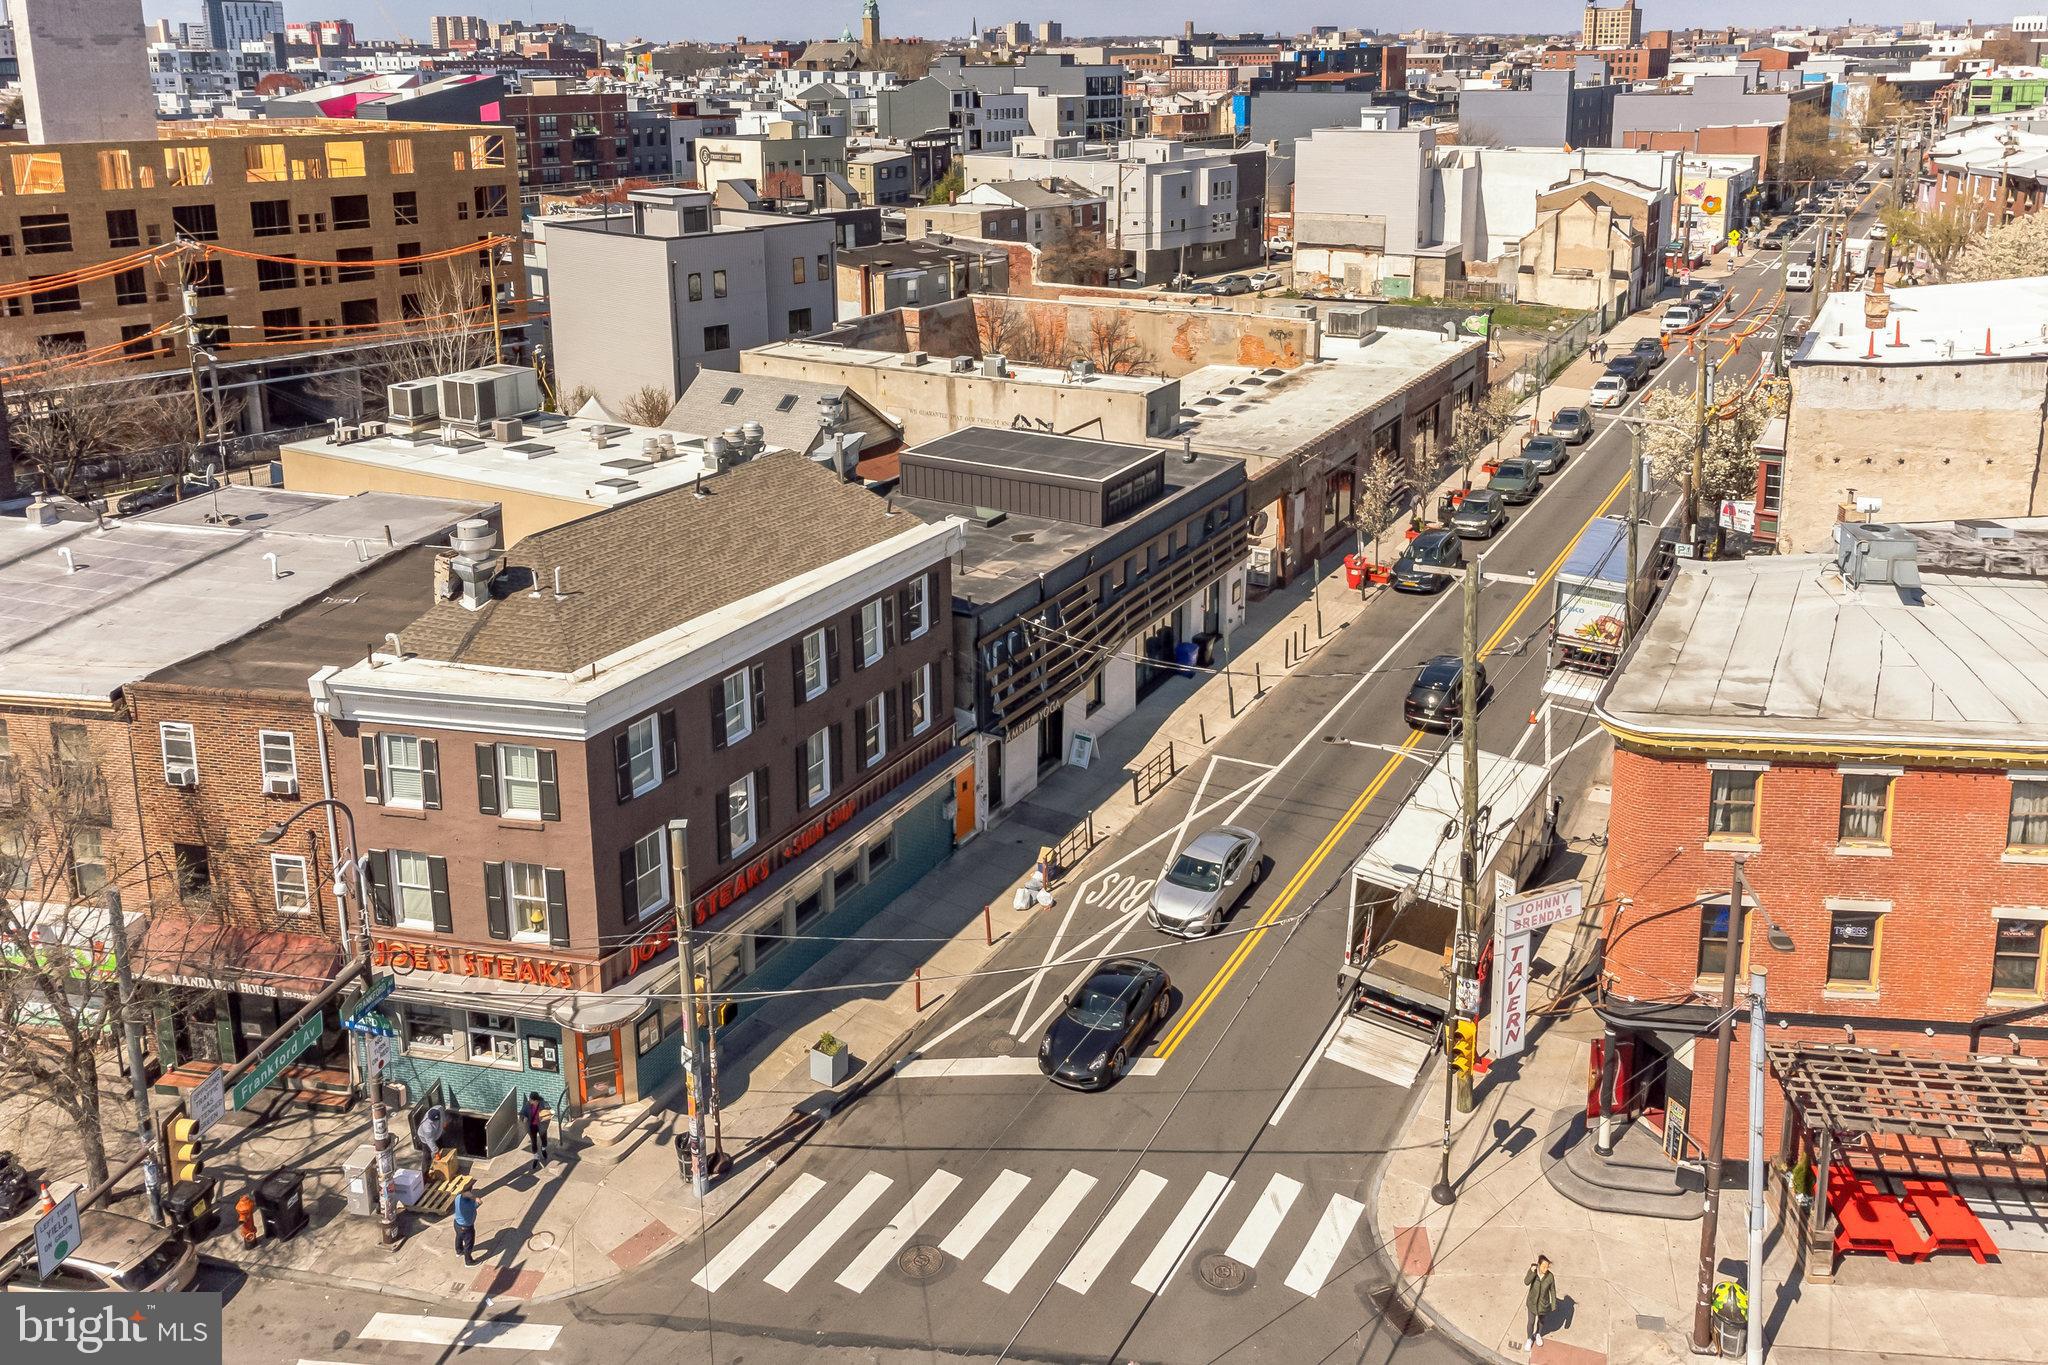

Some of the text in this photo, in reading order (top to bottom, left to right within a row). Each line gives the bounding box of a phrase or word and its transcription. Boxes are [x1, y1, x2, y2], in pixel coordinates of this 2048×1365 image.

[1038, 699, 1061, 720] YOGA
[694, 856, 770, 925] STEAKS
[1085, 872, 1156, 913] BUS
[1516, 893, 1569, 916] JOHNNY
[1514, 905, 1573, 931] BRENDA'S
[373, 939, 574, 989] JOE'S STEAKS
[172, 974, 236, 992] MANDARIN
[240, 982, 278, 997] HOUSE
[1504, 944, 1526, 1045] TAVERN
[241, 1026, 315, 1100] Frankford Av
[40, 1201, 72, 1233] LEFT TURN
[46, 1216, 68, 1238] YIELD
[44, 1223, 73, 1252] ON GREEN
